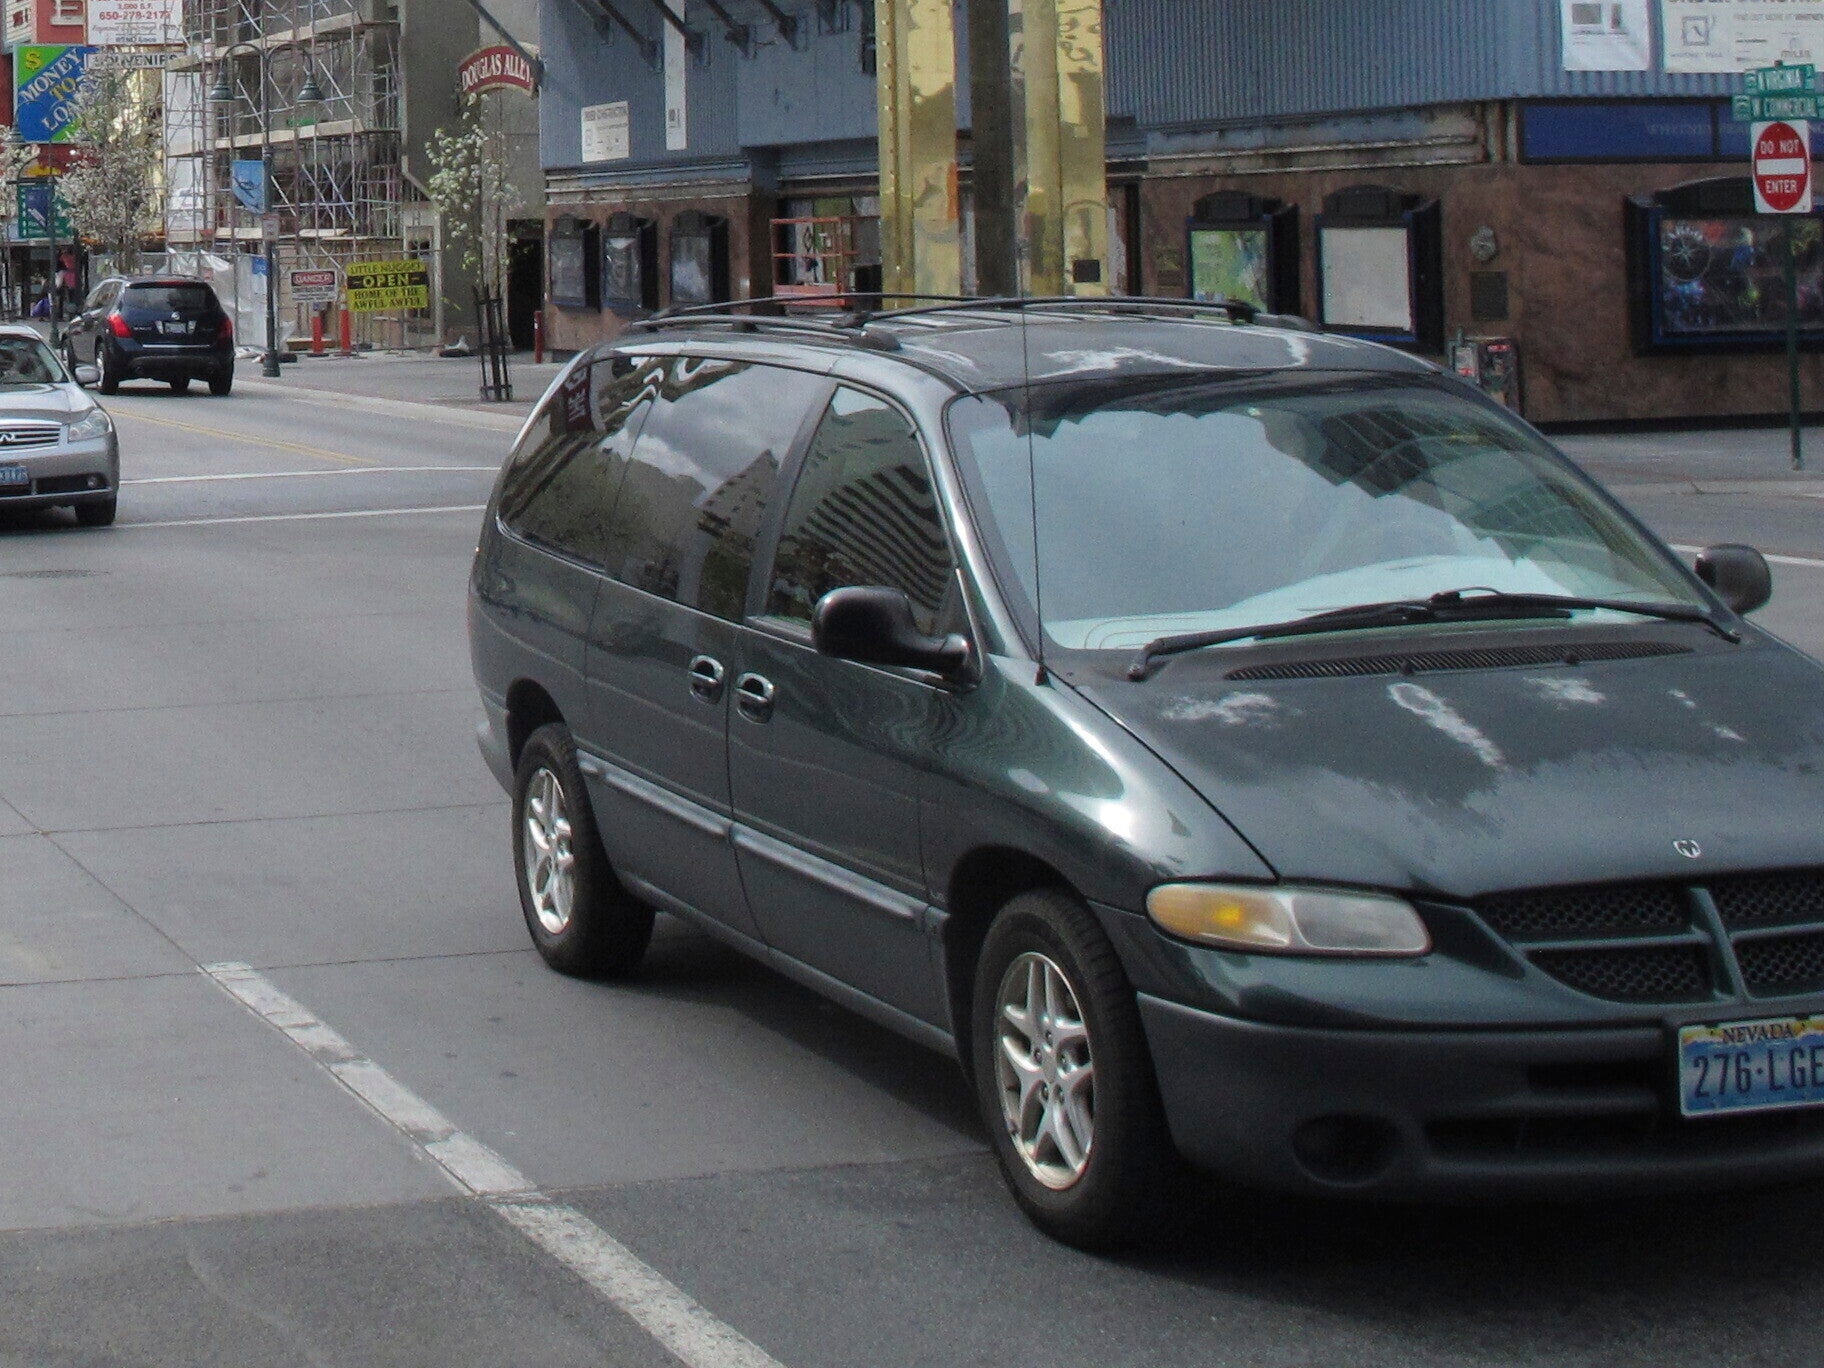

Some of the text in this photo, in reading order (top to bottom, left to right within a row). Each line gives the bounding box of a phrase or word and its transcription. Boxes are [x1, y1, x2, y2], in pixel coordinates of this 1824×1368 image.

[19, 48, 81, 102] MONEY
[461, 54, 530, 91] DOUGLAS ALLEY
[50, 77, 76, 101] TO
[1760, 139, 1799, 154] DO NOT
[1765, 180, 1797, 194] ENTER
[293, 273, 331, 285] DANGER
[354, 289, 381, 299] HOME
[386, 288, 397, 297] OF
[1723, 1023, 1794, 1044] NEVADA
